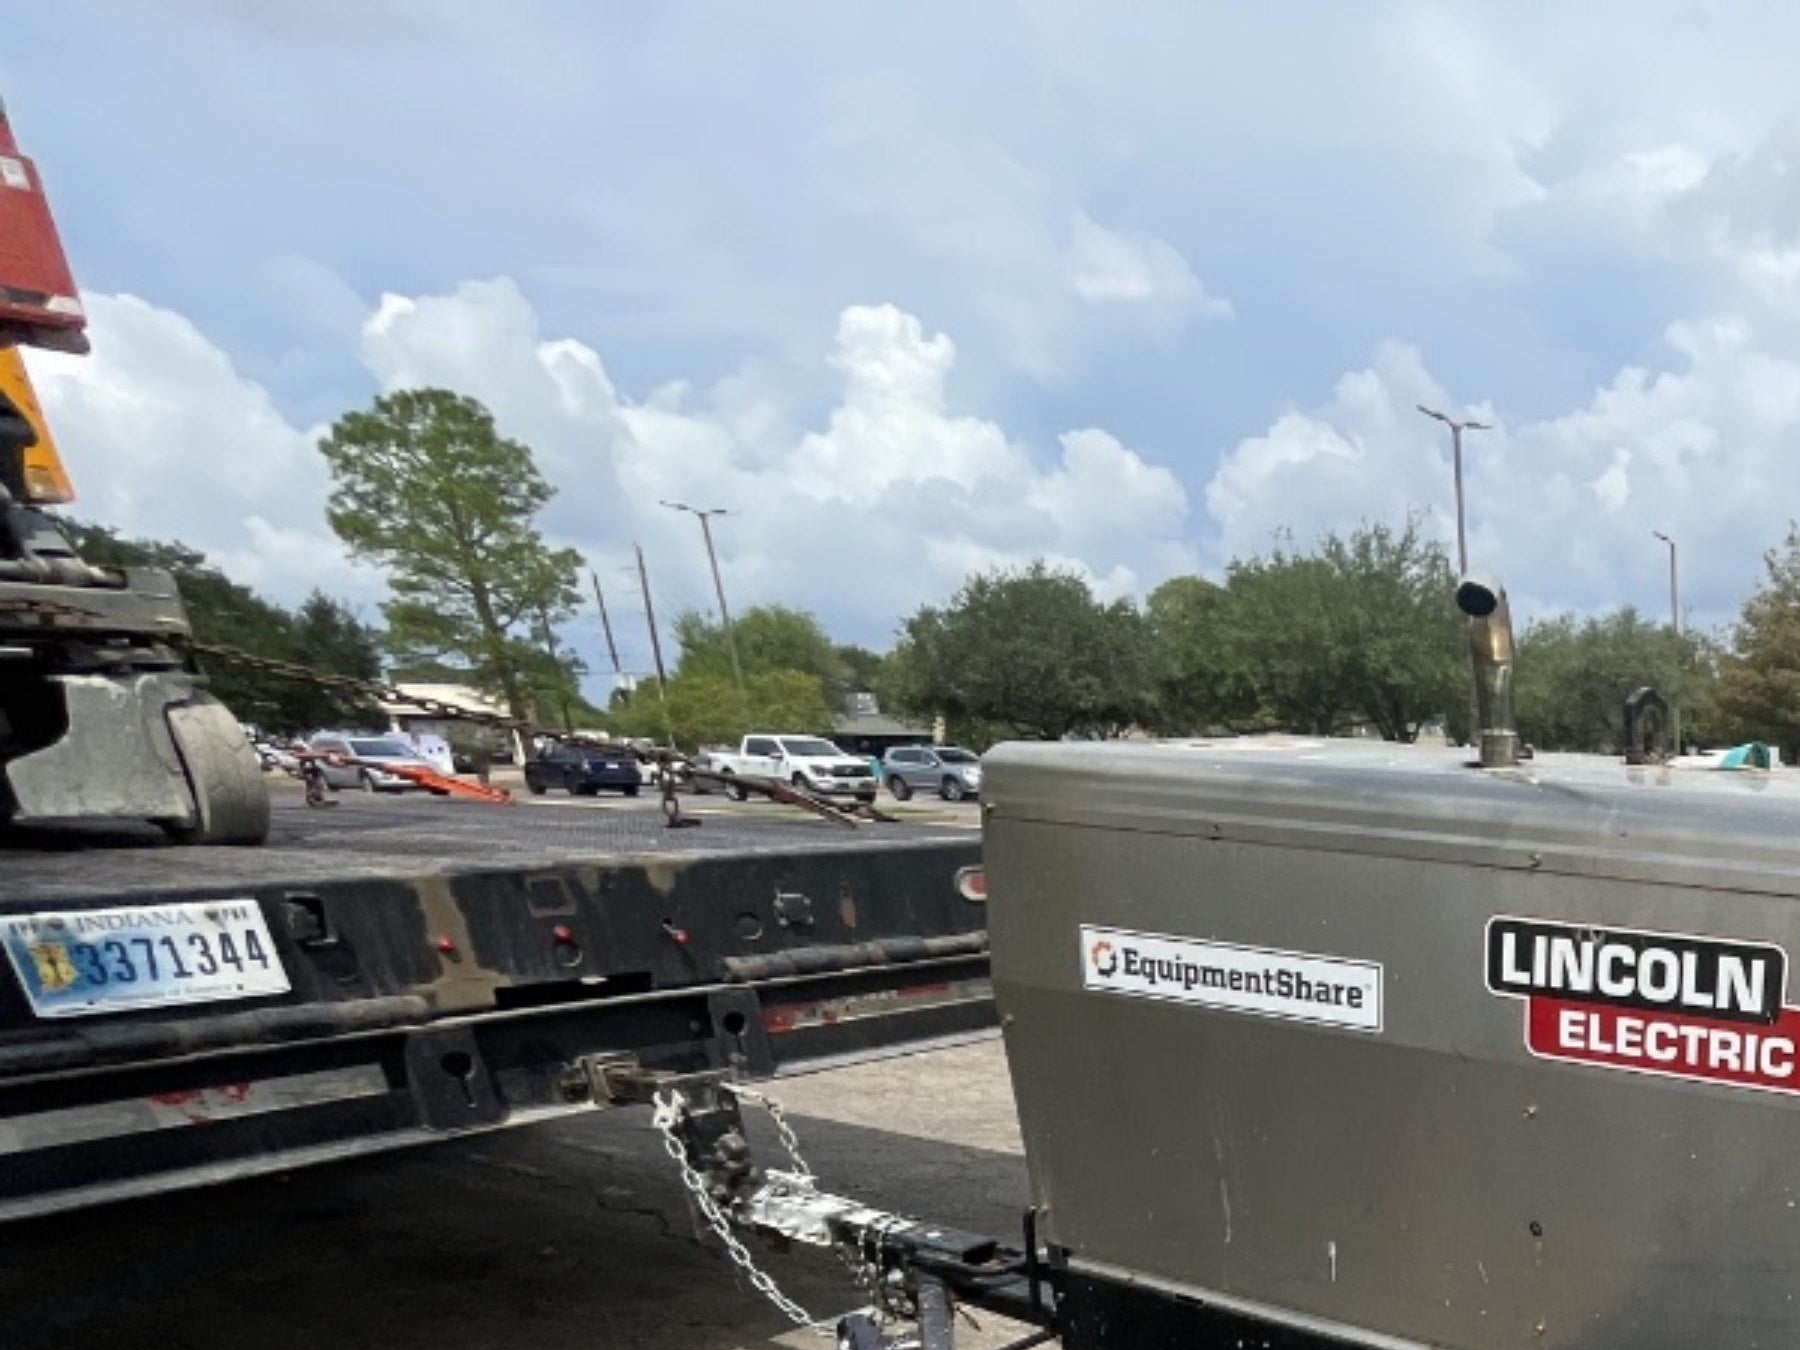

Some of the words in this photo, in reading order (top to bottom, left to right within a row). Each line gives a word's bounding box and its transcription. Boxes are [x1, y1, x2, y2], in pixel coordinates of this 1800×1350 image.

[76, 908, 195, 933] INDIANA
[74, 928, 269, 986] 3371344
[1121, 947, 1363, 1009] EquipmentShare
[1501, 931, 1766, 1013] LINCOLN
[1558, 1008, 1795, 1078] ELECTRIC
